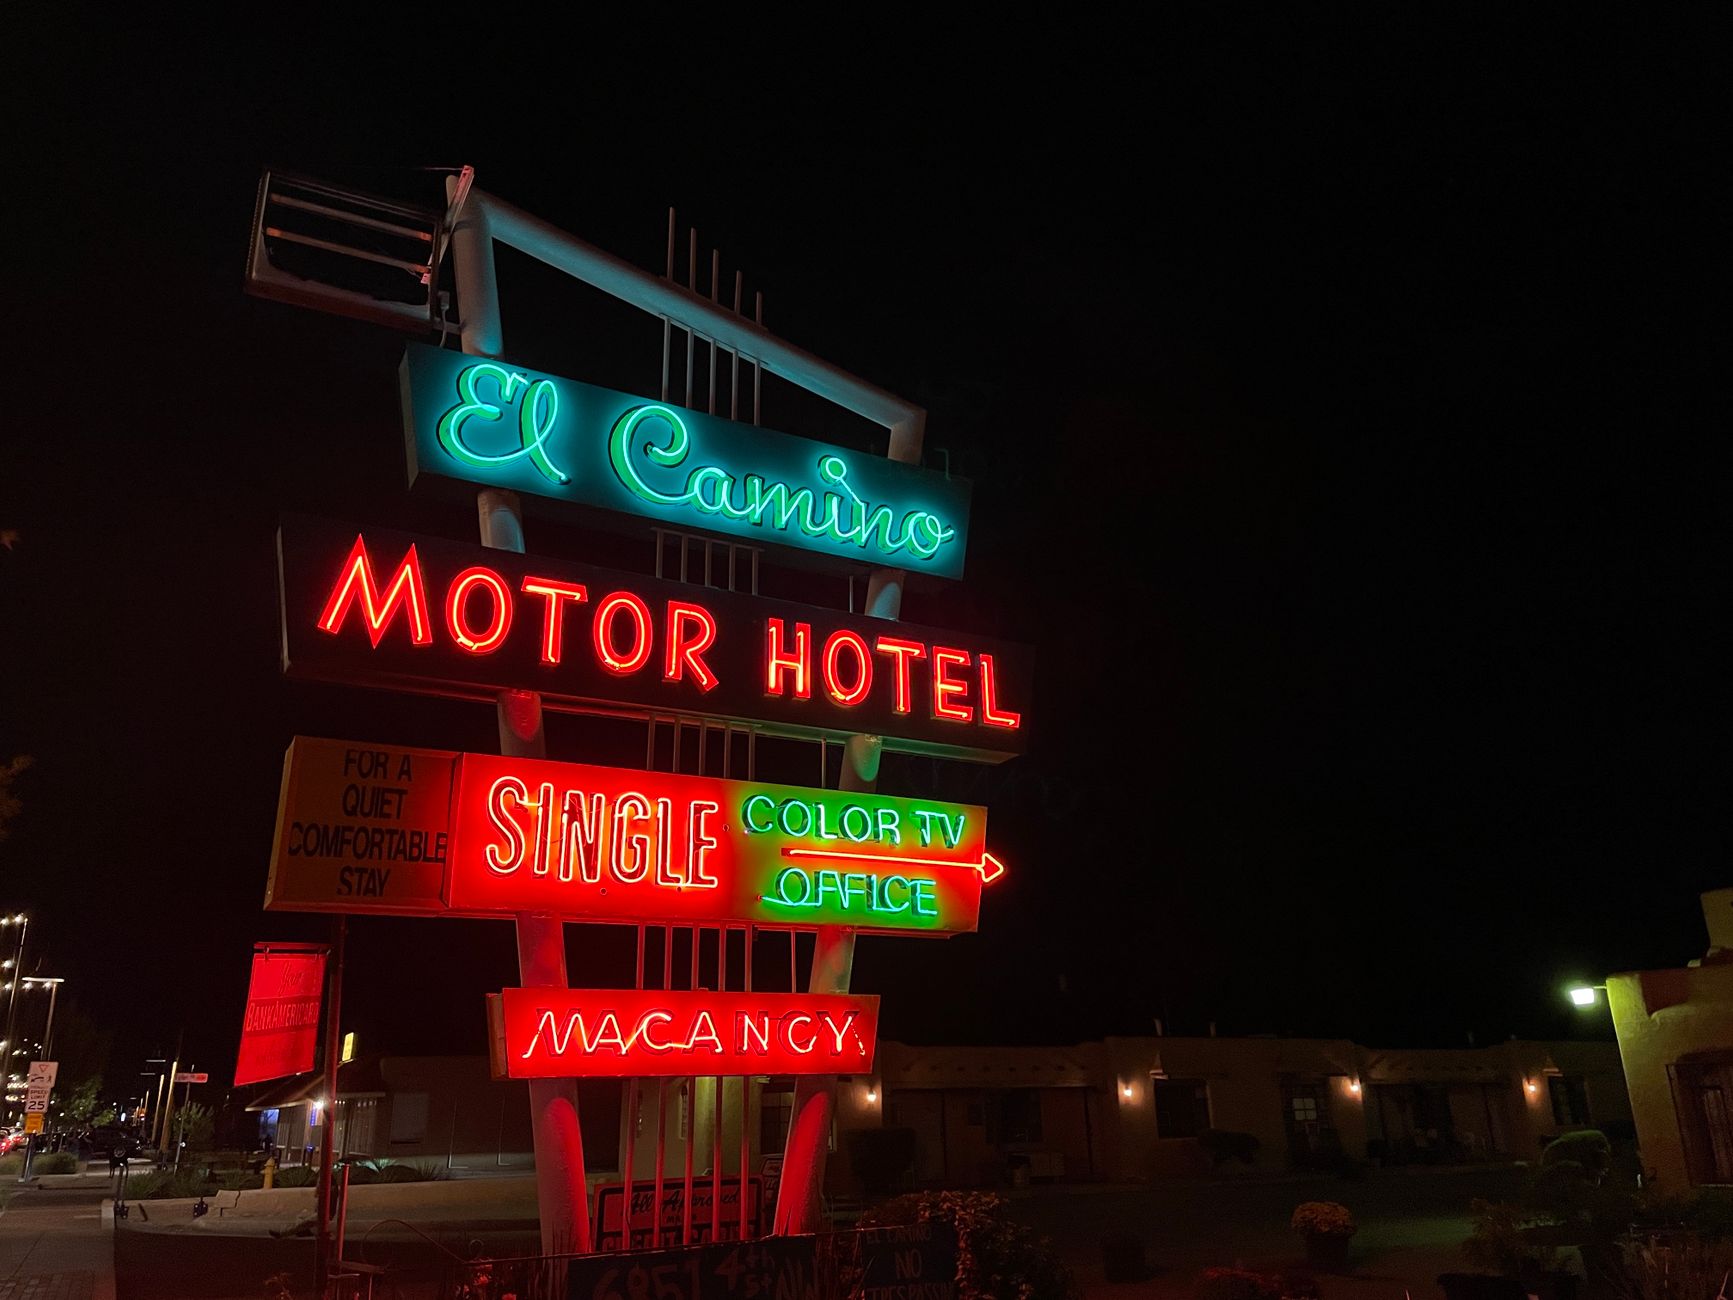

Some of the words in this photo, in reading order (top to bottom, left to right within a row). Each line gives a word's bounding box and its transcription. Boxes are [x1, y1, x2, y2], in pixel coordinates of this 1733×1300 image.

[438, 363, 571, 486] El
[608, 404, 954, 561] Camino
[317, 533, 719, 695] MOTOR
[767, 617, 1021, 729] HOTEL
[344, 749, 390, 780] FOR
[397, 753, 413, 782] A
[342, 783, 409, 820] QUIET
[740, 793, 902, 845] COLOR
[909, 808, 967, 849] TV
[288, 821, 448, 864] COMFORTABLE
[485, 774, 719, 889] SINGLE
[336, 865, 390, 898] STAY
[773, 865, 938, 916] OFFICE
[28, 1100, 45, 1110] 25
[894, 1248, 922, 1280] NO
